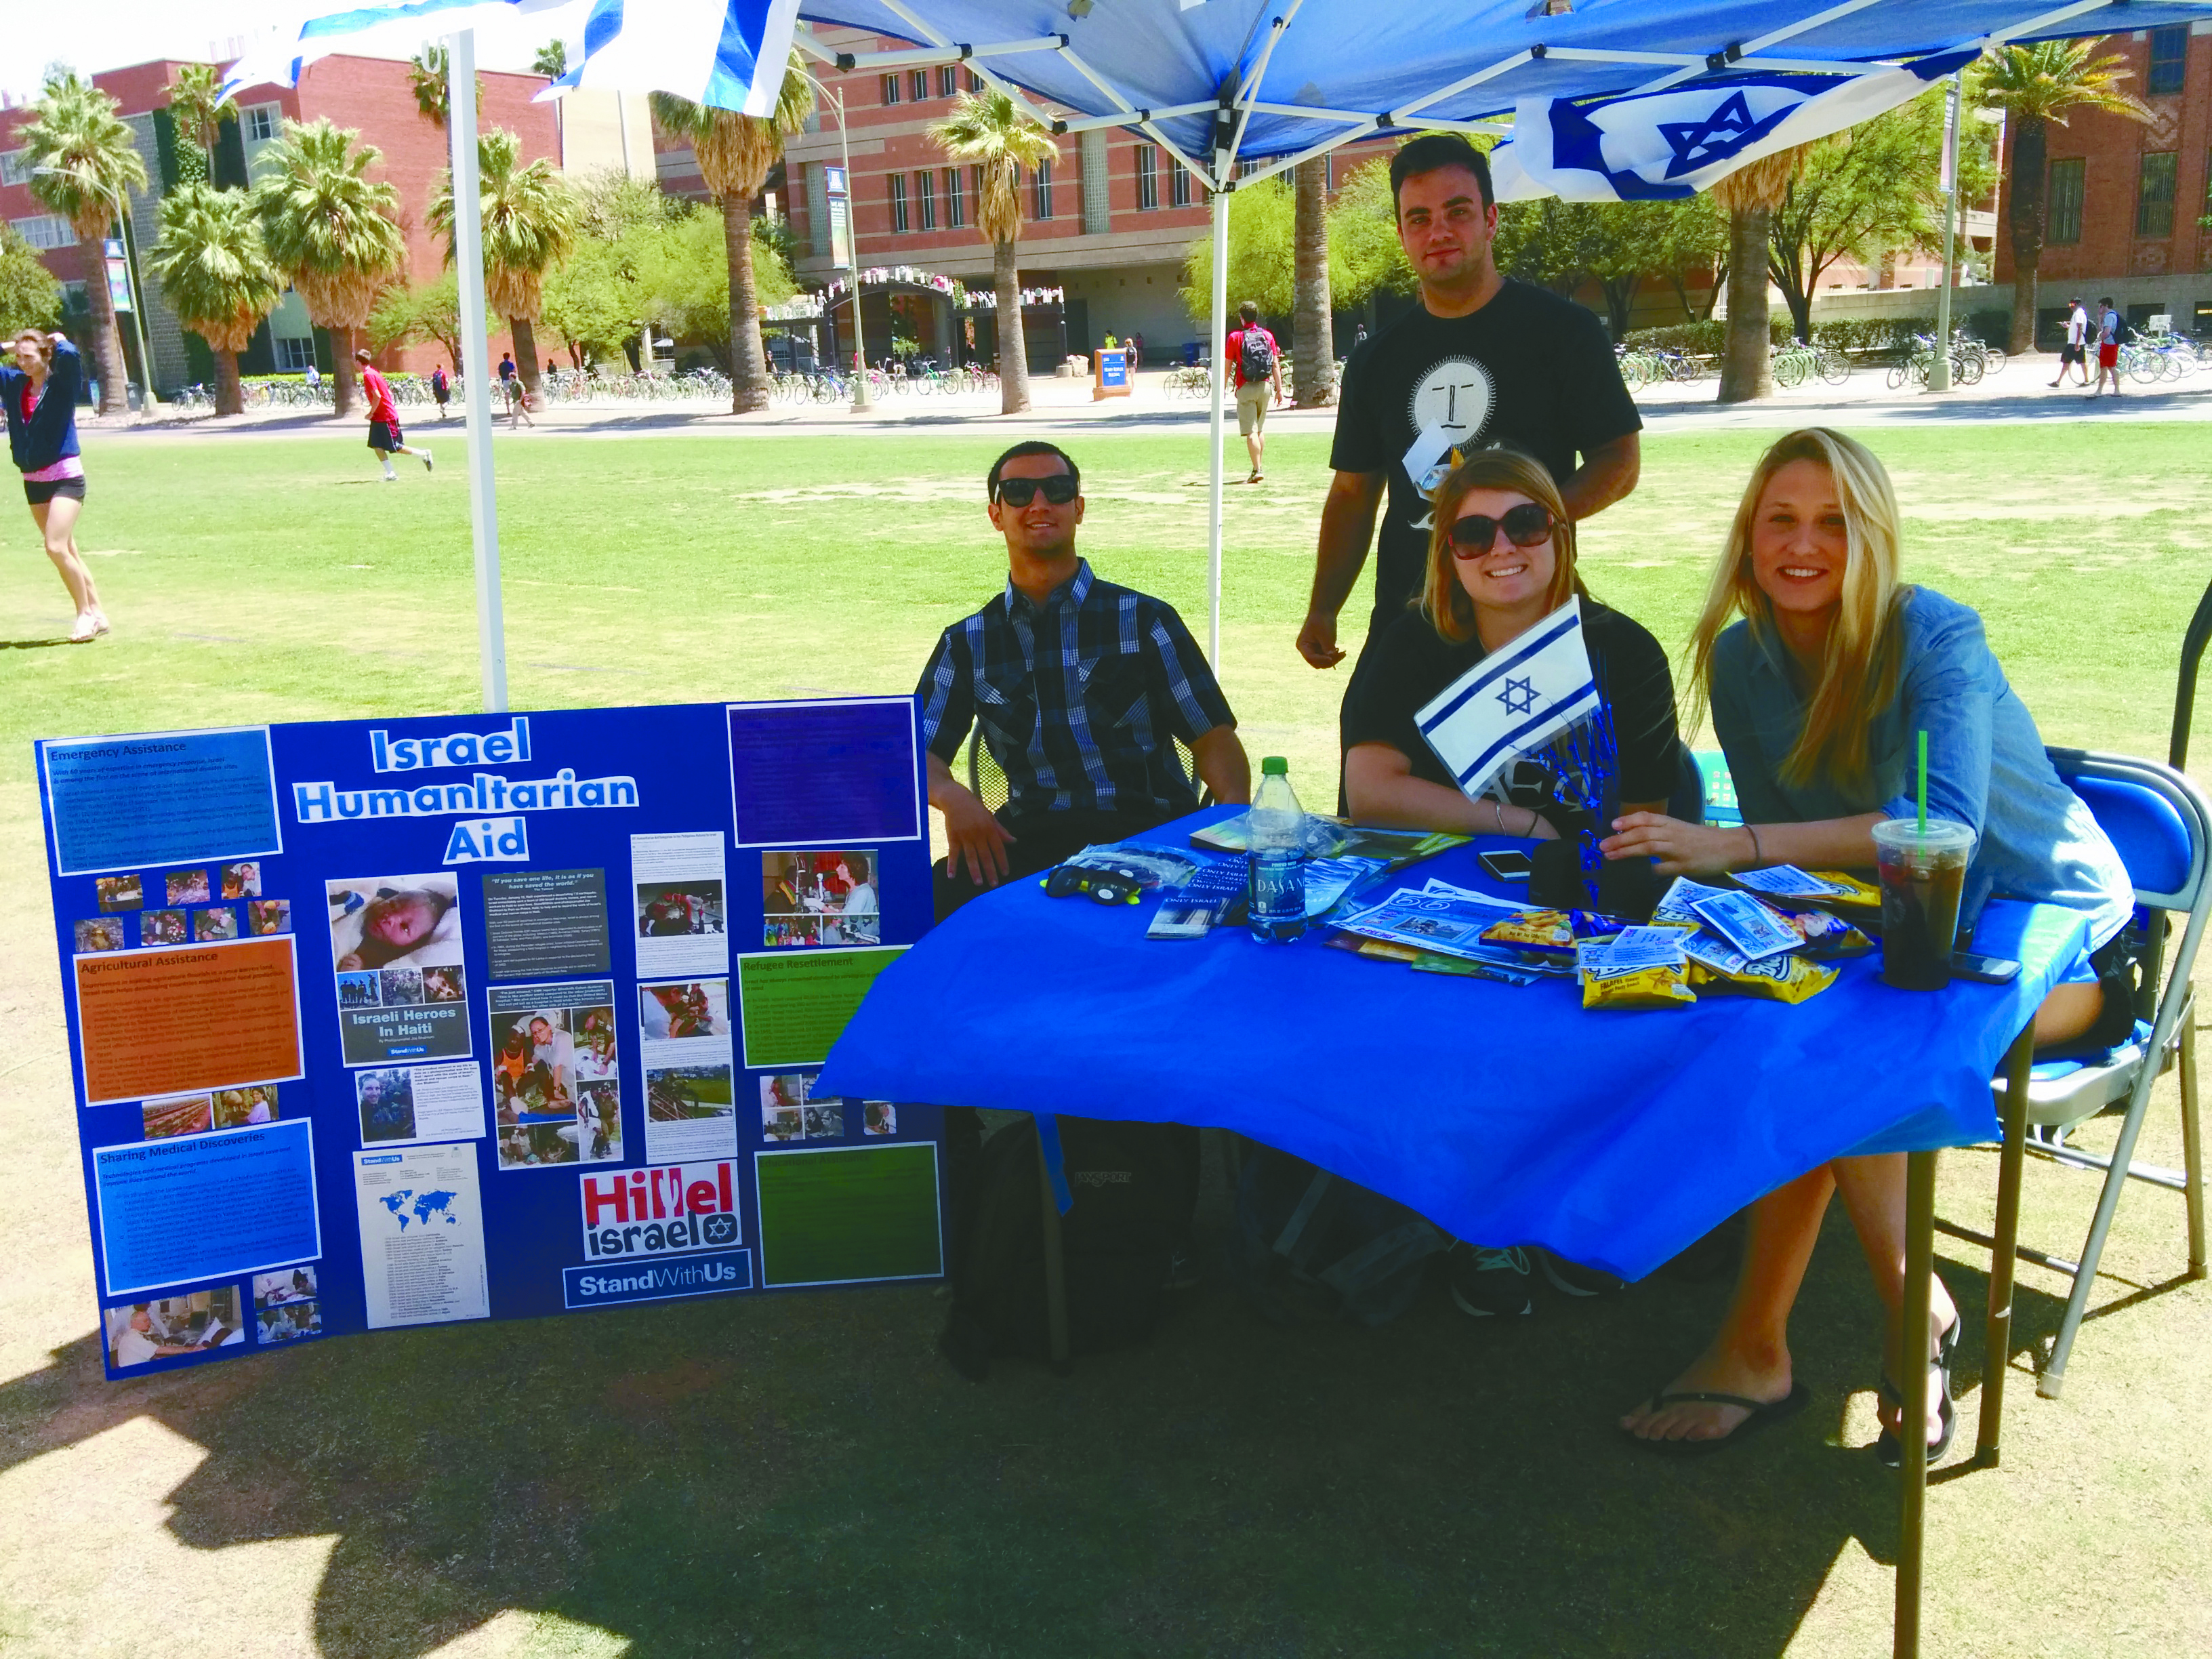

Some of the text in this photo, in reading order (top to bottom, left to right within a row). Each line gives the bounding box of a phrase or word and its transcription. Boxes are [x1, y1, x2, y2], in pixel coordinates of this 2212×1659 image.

[732, 709, 800, 723] Development
[51, 741, 187, 761] Emergency Assistance
[372, 718, 530, 769] Israel
[447, 819, 526, 860] Aid
[1258, 878, 1305, 896] DASAN
[1389, 894, 1457, 911] 66
[81, 951, 218, 975] Agricultural Assistance
[743, 956, 853, 972] Refugee Resettlement
[1600, 979, 1624, 990] FALAFEL
[352, 1006, 456, 1024] Israeli Heroes
[379, 1023, 432, 1037] In Haiti
[100, 1132, 266, 1164] Sharing Medical Discoveries
[363, 1155, 400, 1166] StandWithUs
[759, 1153, 872, 1169] Educational Assistance
[1073, 1171, 1132, 1187] JANSPORT
[584, 1162, 733, 1225] Hillel
[588, 1210, 700, 1256] israel
[579, 1263, 737, 1297] StandWithUs
